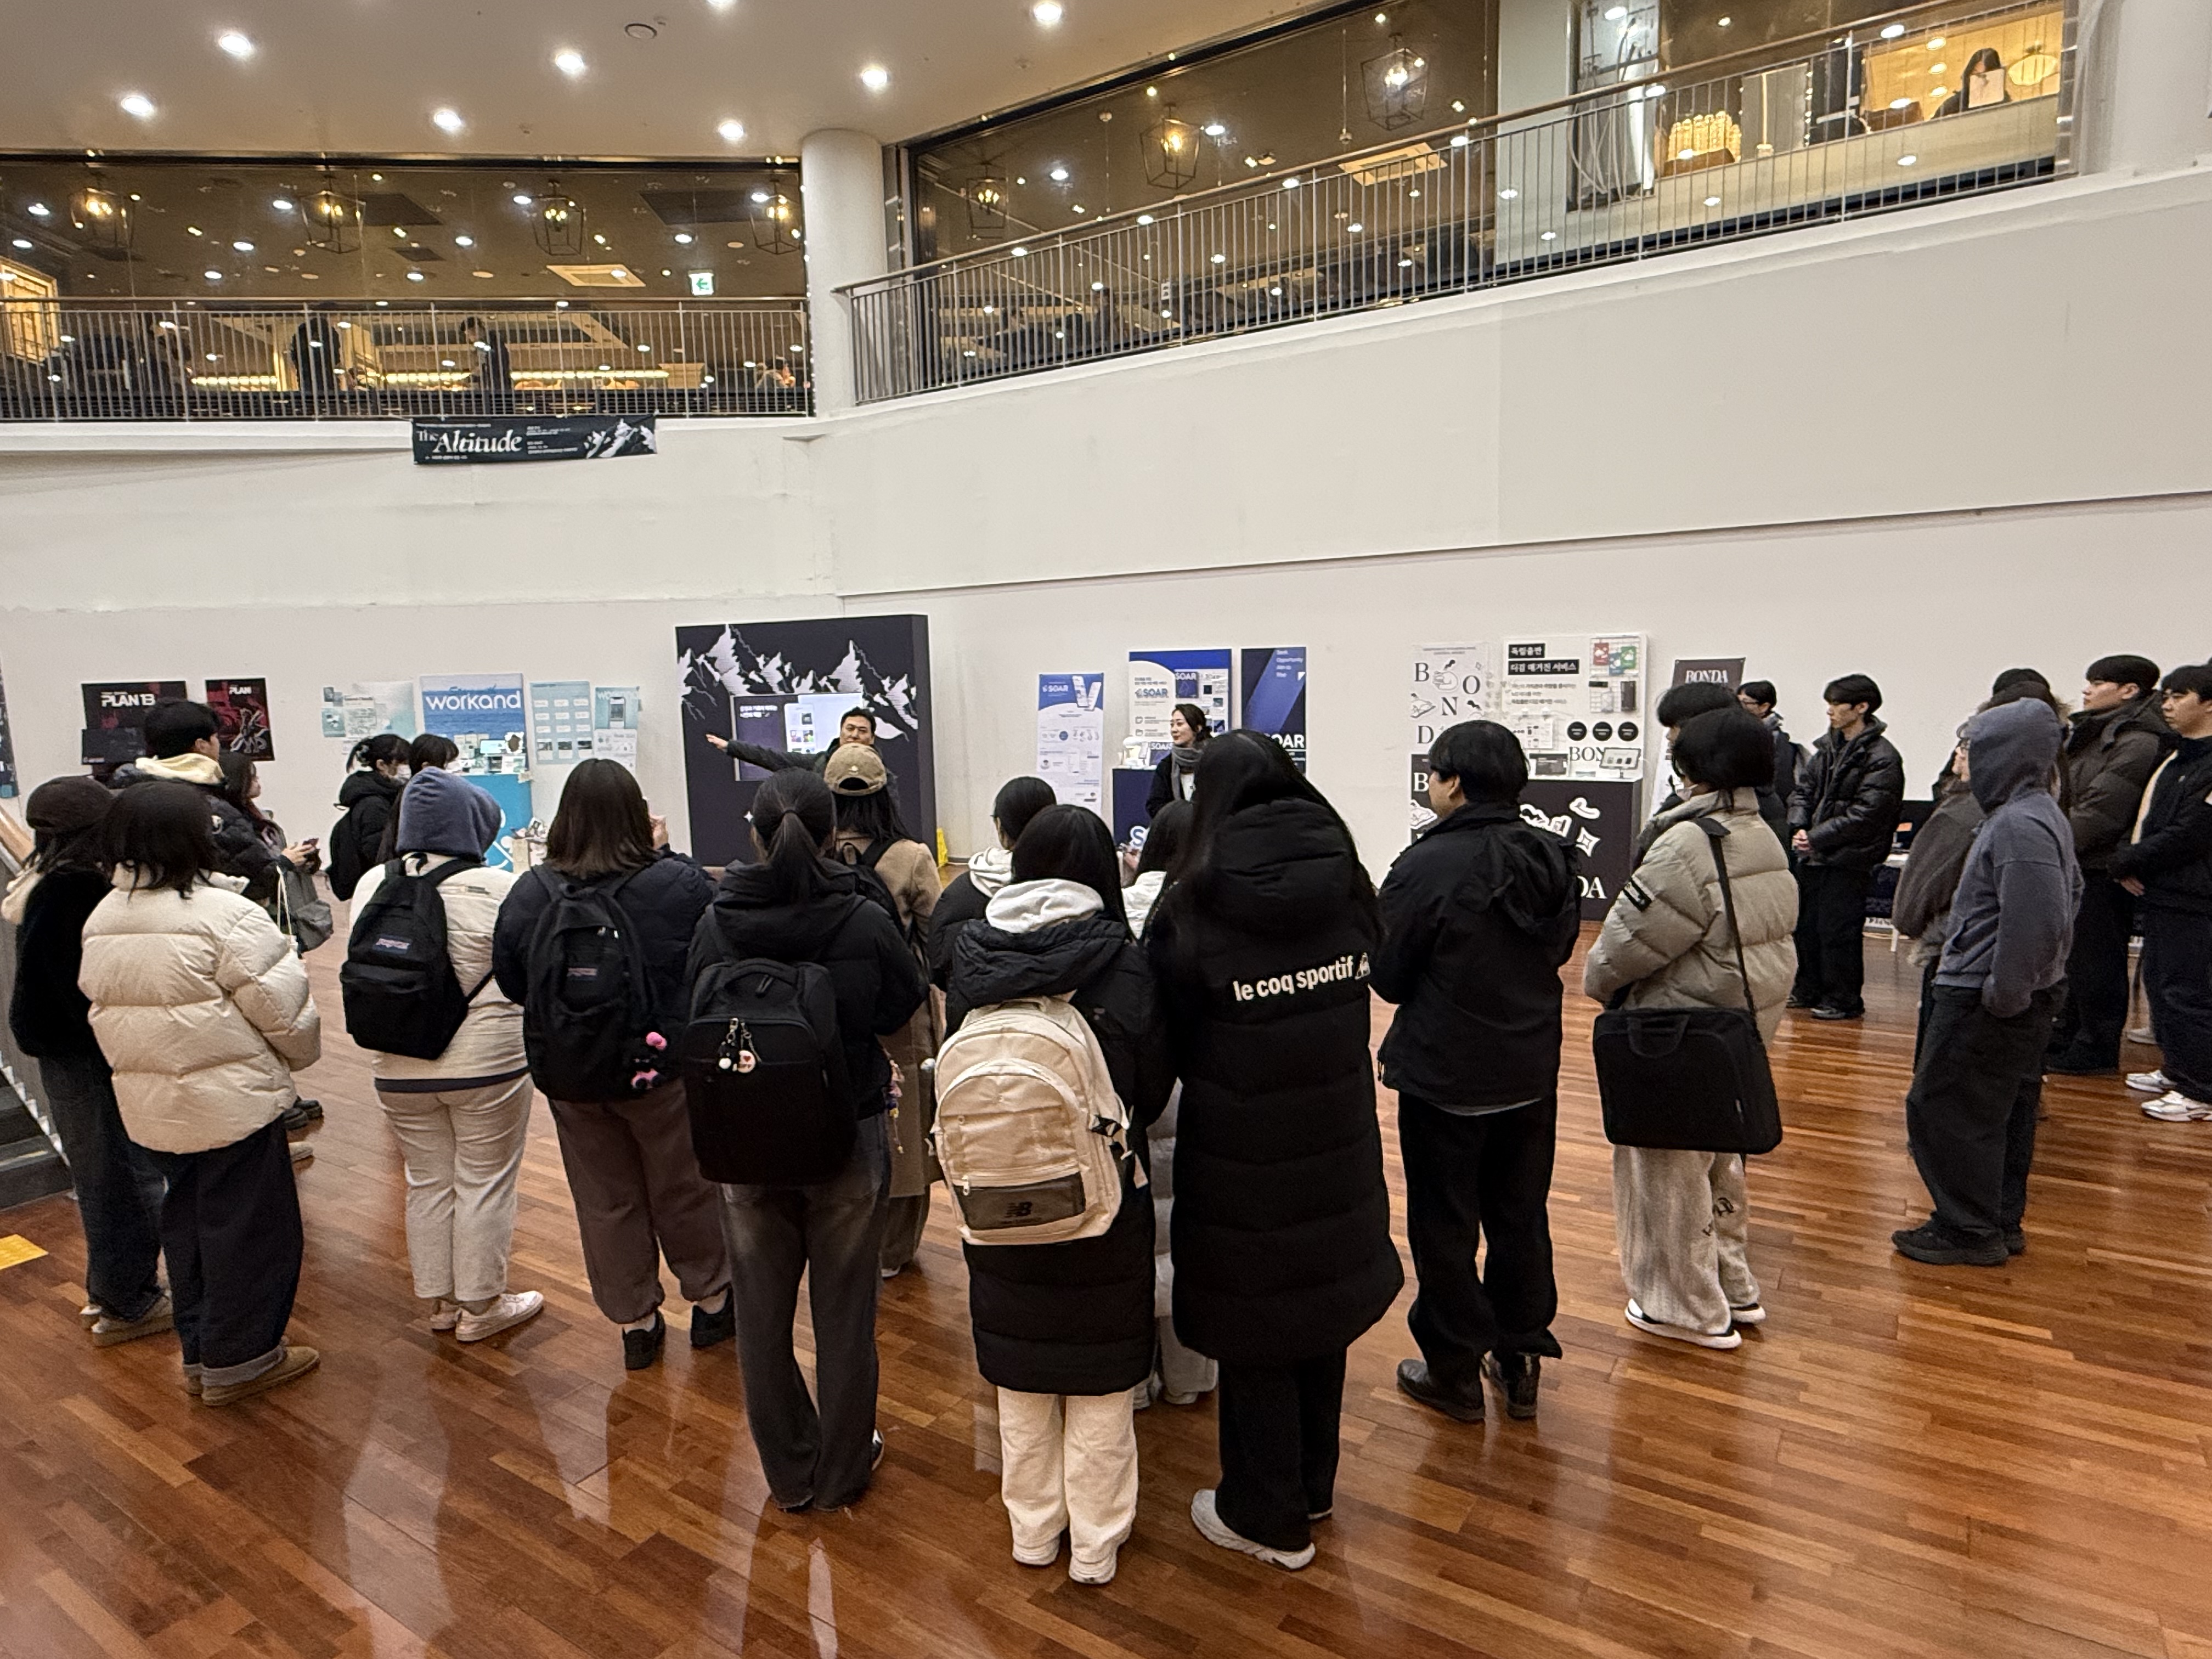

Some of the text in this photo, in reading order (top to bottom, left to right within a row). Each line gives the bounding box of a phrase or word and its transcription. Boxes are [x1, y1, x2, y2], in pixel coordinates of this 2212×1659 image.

[432, 429, 522, 452] Altitude
[1175, 672, 1197, 681] SOAR
[1414, 662, 1430, 682] B
[229, 687, 252, 696] PLAN
[1048, 684, 1069, 692] SOAR
[1143, 687, 1169, 699] SOAR
[101, 693, 140, 708] PLAN
[426, 690, 522, 711] workand
[1233, 955, 1355, 1002] le coq sportif
